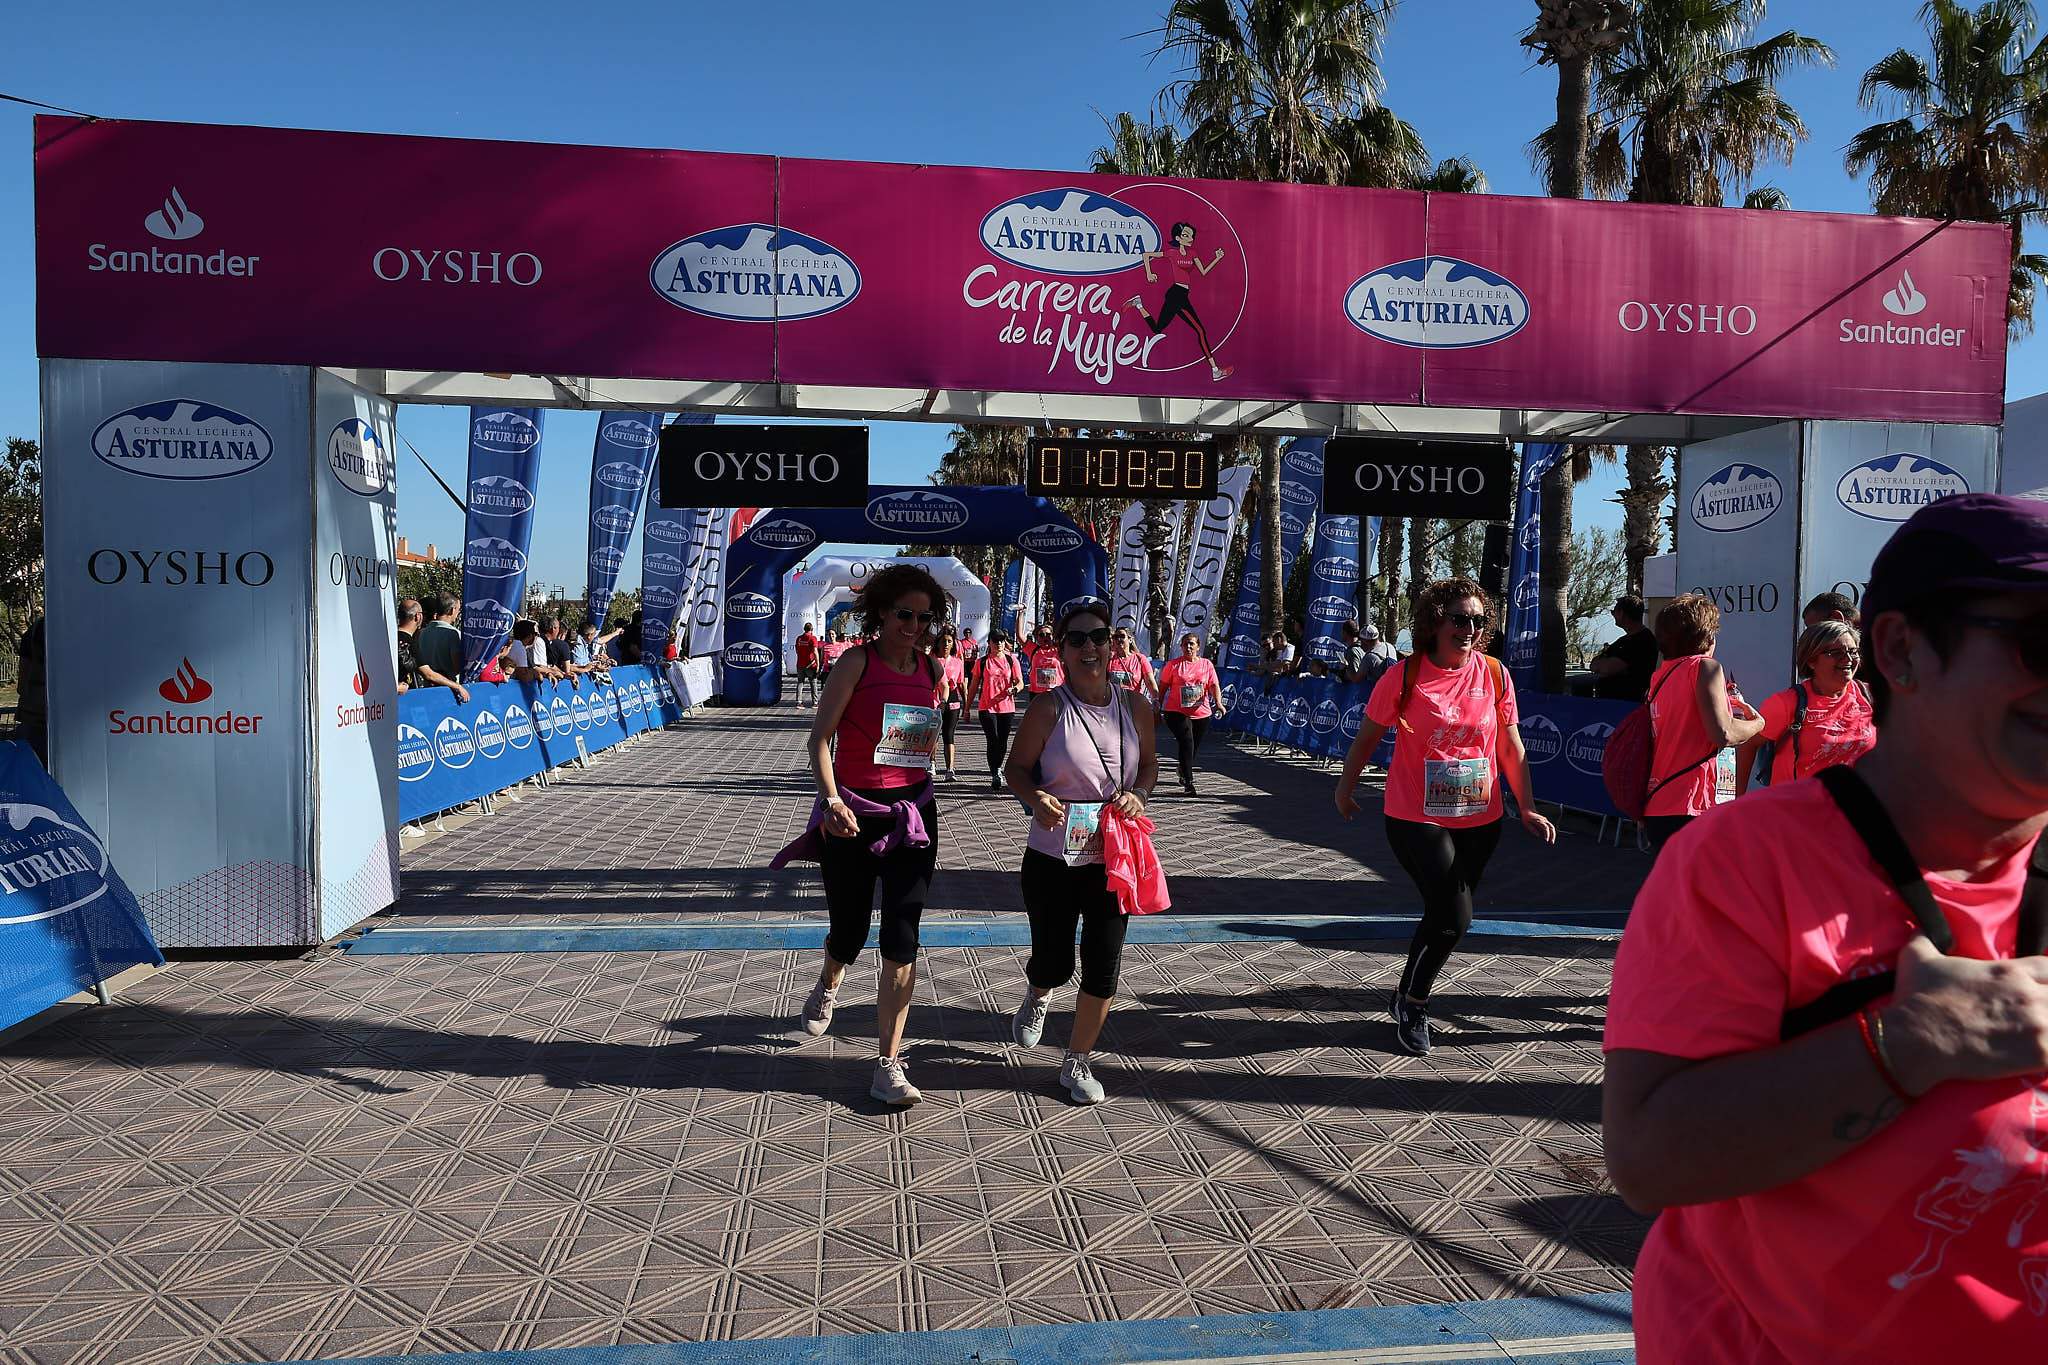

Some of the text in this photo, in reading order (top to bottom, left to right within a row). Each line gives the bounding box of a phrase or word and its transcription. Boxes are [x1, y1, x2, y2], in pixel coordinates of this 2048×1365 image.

[993, 216, 1146, 255] ASTURIANA
[1022, 215, 1143, 231] CENTRAL LECHERA
[88, 242, 260, 278] Santander
[372, 246, 543, 288] OYSHO
[699, 256, 766, 268] CENTRAL
[666, 257, 846, 298] ASTURIANA
[963, 265, 1113, 315] Carrera
[1357, 287, 1516, 326] ASTURIANA
[1387, 286, 1510, 300] CENTRAL LECHERA
[1617, 300, 1757, 336] OYSHO
[1839, 318, 1966, 348] Santander
[998, 312, 1167, 385] de la Mujer
[105, 428, 261, 461] ASTURIANA
[133, 426, 254, 438] CENTRAL LECHERA
[333, 439, 386, 482] ASTURIANA
[693, 450, 840, 483] OYSHO
[1040, 447, 1204, 488] 01:08:20
[1354, 462, 1486, 495] OYSHO
[1866, 476, 1957, 486] CENTRAL LECHERA
[1281, 487, 1313, 503] STURIANA
[1695, 491, 1775, 519] ASTURIANA
[872, 502, 962, 524] ASTURIANA
[753, 529, 811, 543] ASTURIANA
[1023, 535, 1080, 547] ASTURIANA
[1323, 523, 1359, 539] ASTURIA
[87, 548, 275, 587] OYSHO
[329, 551, 390, 590] OYSHO
[727, 601, 772, 614] ASTURIANA
[726, 650, 771, 663] ASTURIANA
[108, 709, 263, 735] Santander
[337, 700, 386, 728] Santander
[439, 738, 474, 759] ASTURIANA
[0, 846, 96, 895] TURIAN
